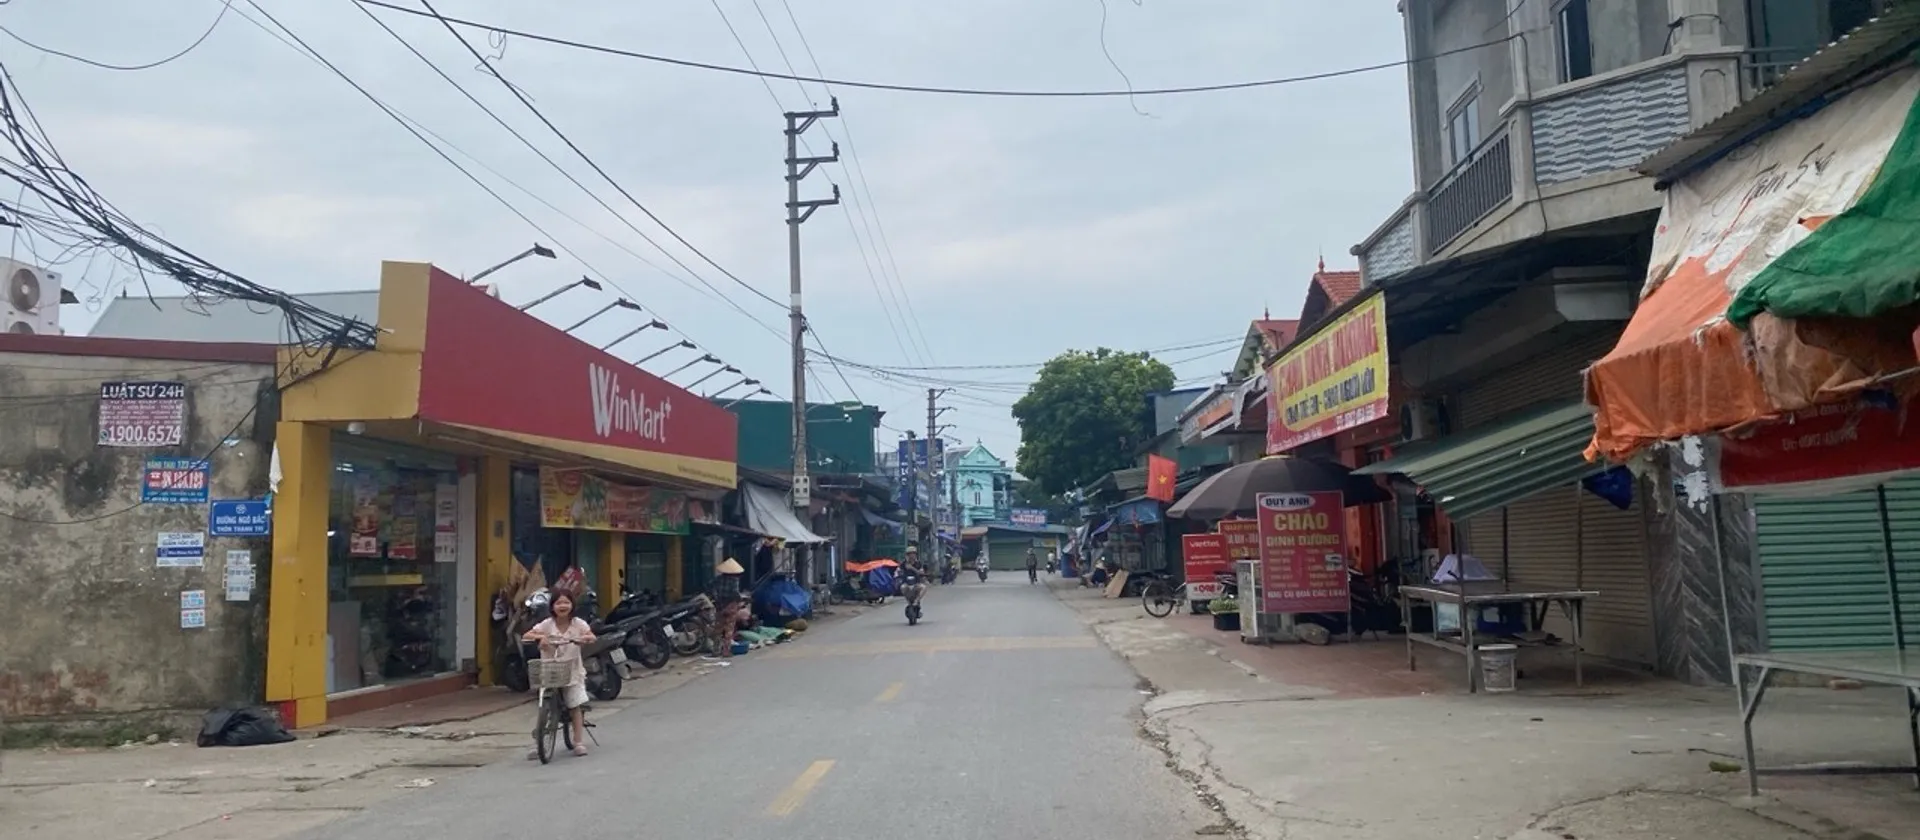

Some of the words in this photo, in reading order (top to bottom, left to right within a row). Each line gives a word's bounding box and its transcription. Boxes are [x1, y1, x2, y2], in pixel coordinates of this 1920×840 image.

[102, 382, 136, 400] LUẬT
[137, 384, 158, 398] SƯ
[158, 385, 184, 398] 24H
[108, 424, 182, 442] 1900.6574
